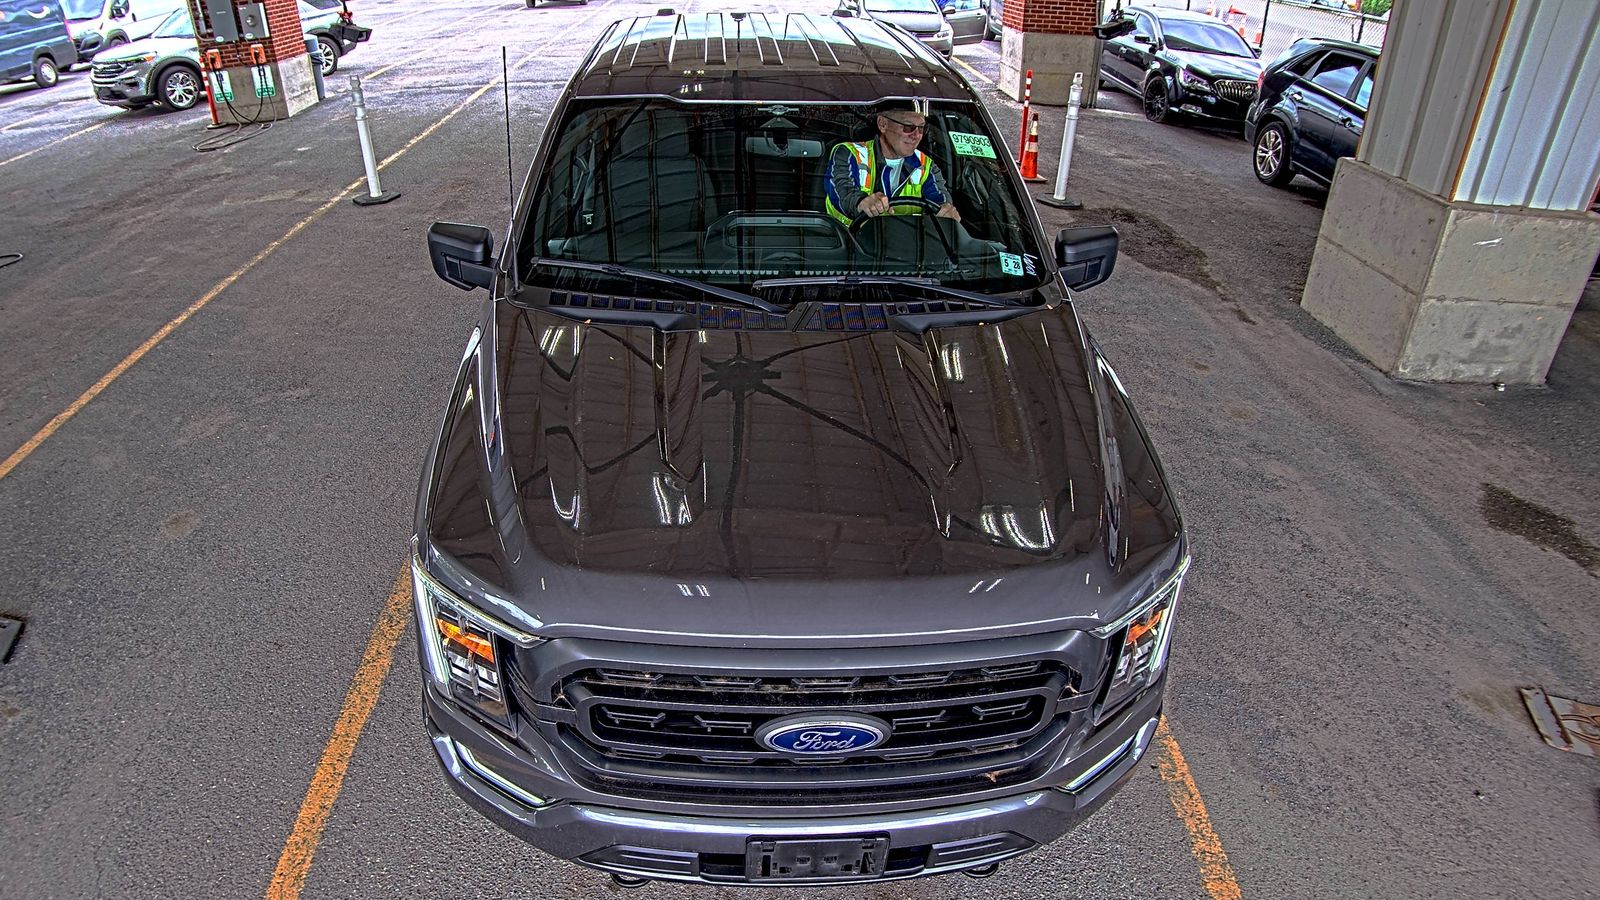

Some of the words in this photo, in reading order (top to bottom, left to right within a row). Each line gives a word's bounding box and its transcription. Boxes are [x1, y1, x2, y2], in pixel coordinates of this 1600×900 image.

[952, 133, 991, 147] 9790903
[1004, 259, 1009, 267] 5
[793, 731, 856, 750] Ford
